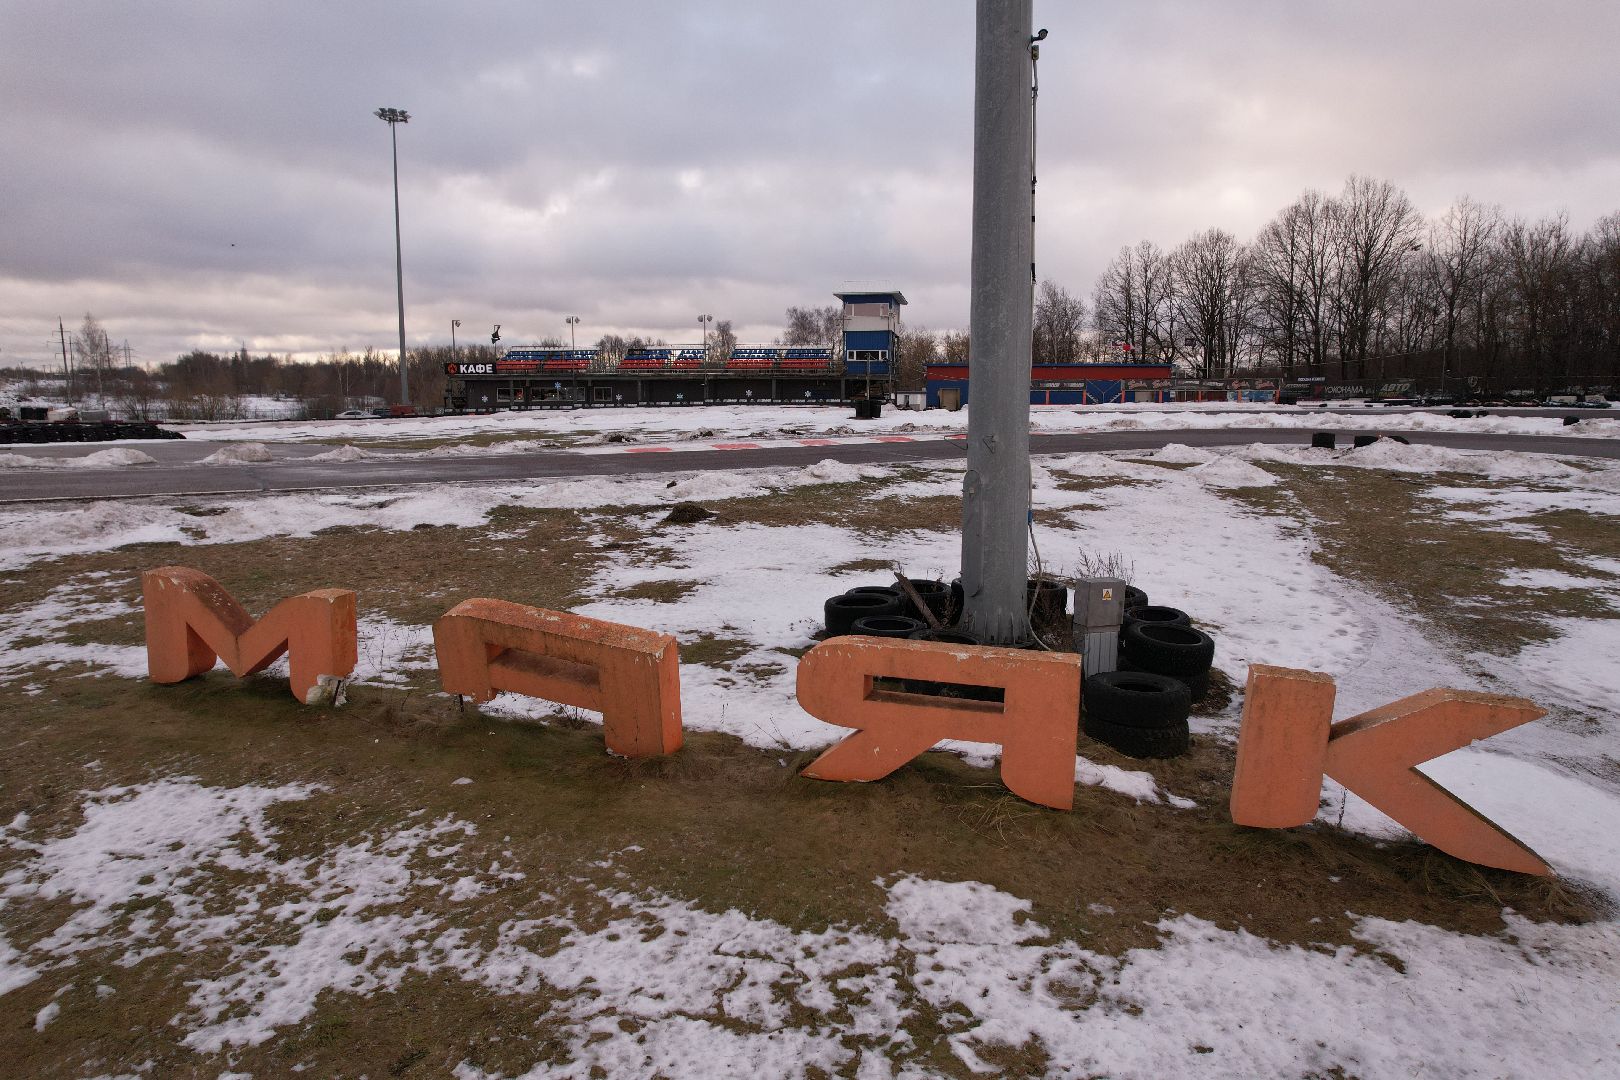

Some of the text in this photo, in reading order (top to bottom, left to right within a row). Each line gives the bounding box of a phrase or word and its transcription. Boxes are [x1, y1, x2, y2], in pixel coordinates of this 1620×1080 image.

[459, 363, 493, 373] КАФЕ
[1324, 385, 1364, 394] YOKOHAMA
[143, 565, 1551, 877] МАЯК
